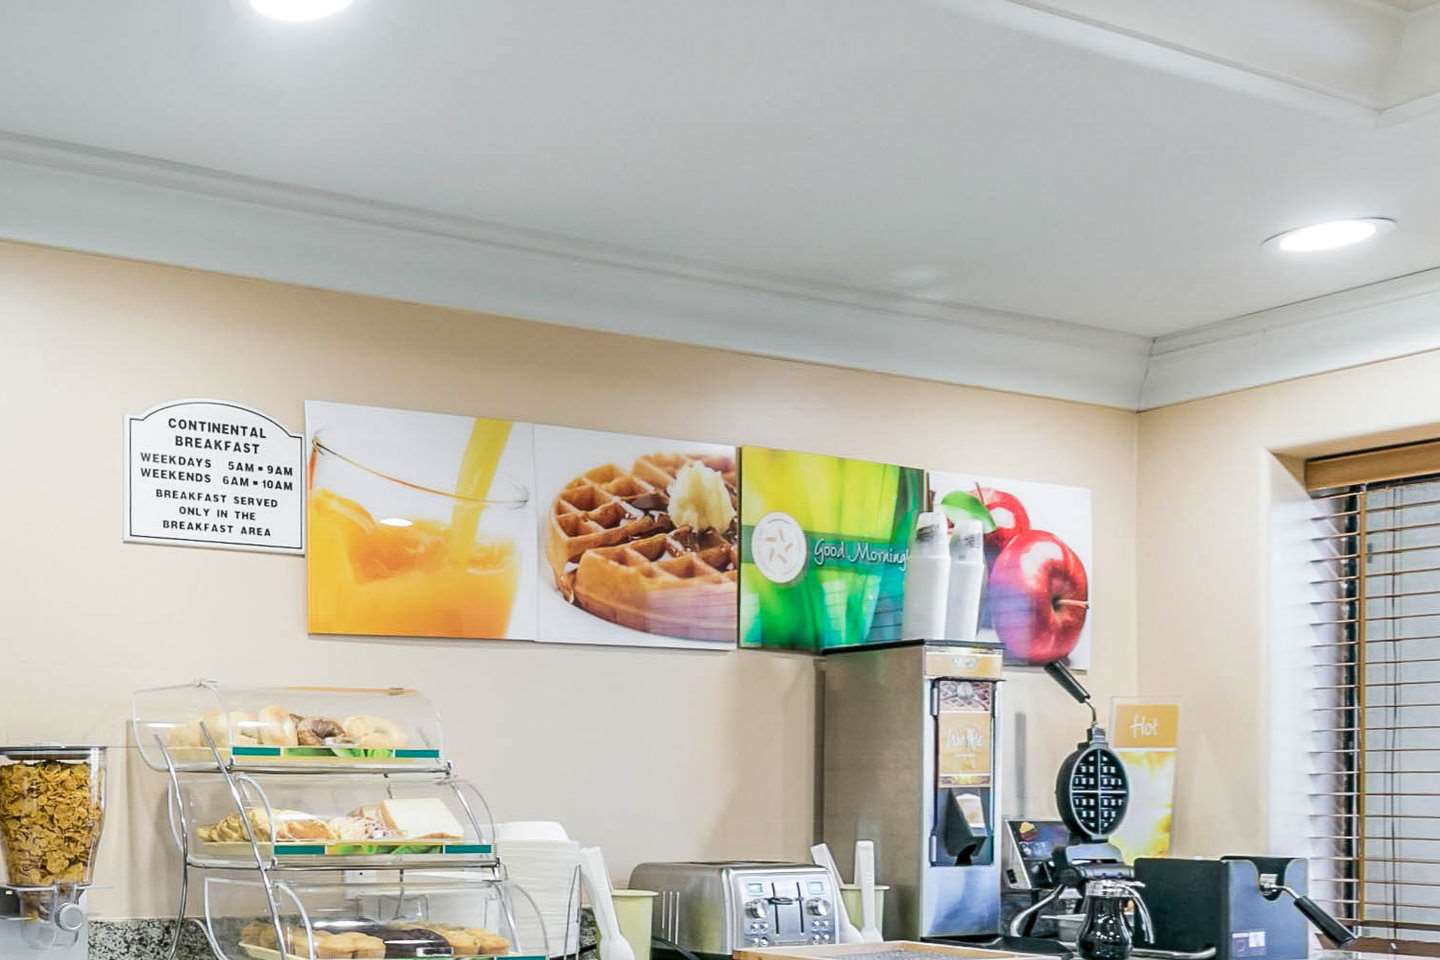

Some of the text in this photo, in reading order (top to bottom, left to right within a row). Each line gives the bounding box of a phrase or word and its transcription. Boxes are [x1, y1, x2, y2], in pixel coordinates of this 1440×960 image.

[168, 418, 267, 439] CONTINENTAL
[175, 436, 260, 454] BREAKFAST
[140, 452, 293, 477] WEEKDAYS 5AM 9AM
[140, 468, 293, 491] WEEKENDS 6AM 10AM
[156, 488, 278, 508] BREAKFAST SERVED
[179, 506, 256, 521] ONLY IN THE
[162, 520, 271, 537] BREAKFAST AREA
[814, 538, 846, 564] Good
[1129, 711, 1159, 739] Hot
